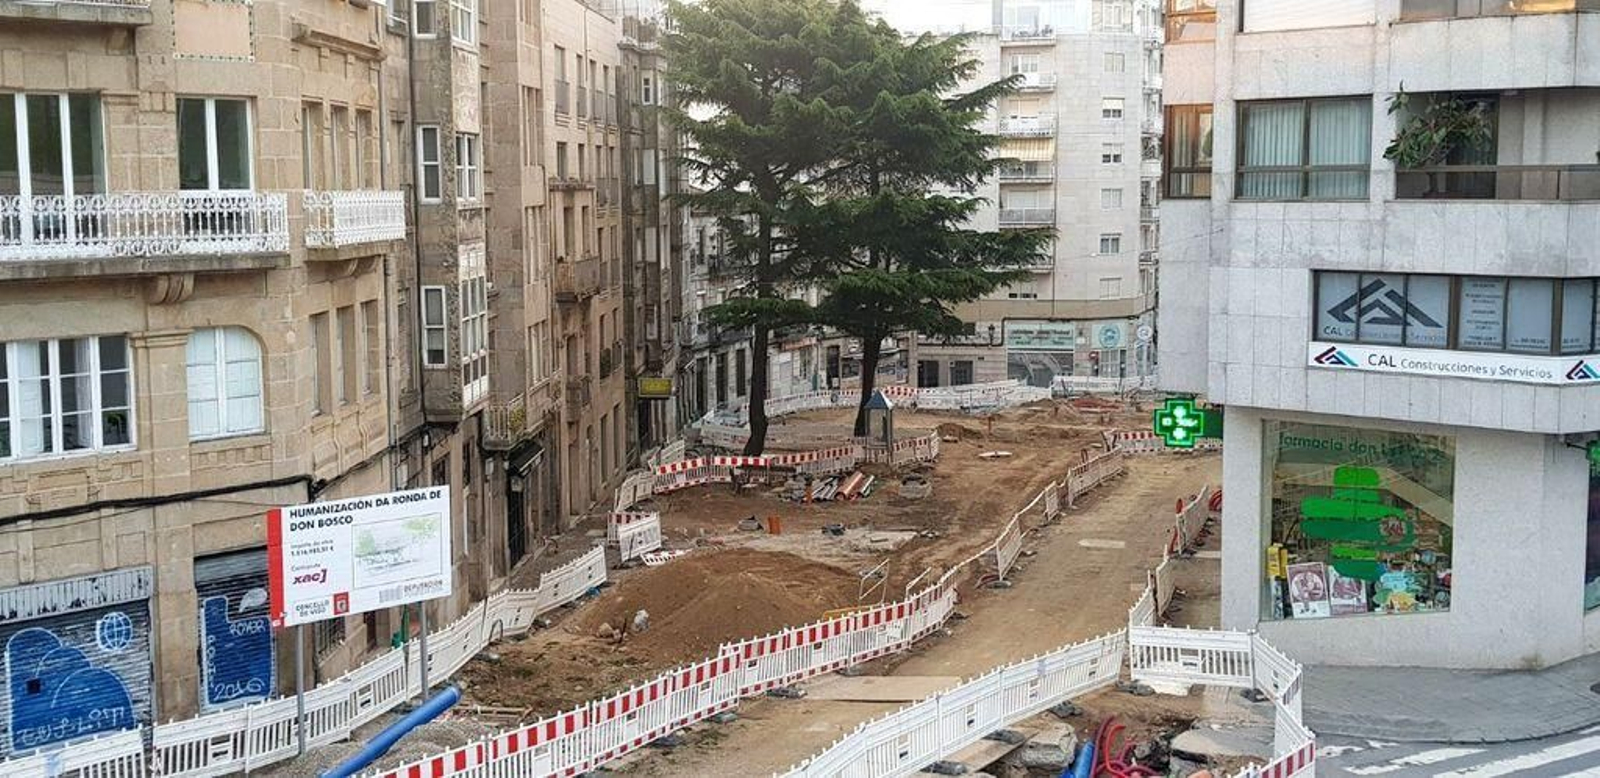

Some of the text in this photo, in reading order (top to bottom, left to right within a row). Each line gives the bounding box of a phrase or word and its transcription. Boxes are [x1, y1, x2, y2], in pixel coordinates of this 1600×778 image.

[1367, 353, 1552, 379] CAL Construcciones y Servicios
[1278, 432, 1343, 451] farmacia
[1349, 437, 1377, 454] don
[375, 497, 390, 507] DA
[392, 493, 427, 505] RONDA
[429, 489, 442, 499] DE
[289, 514, 354, 532] DON BOSCO
